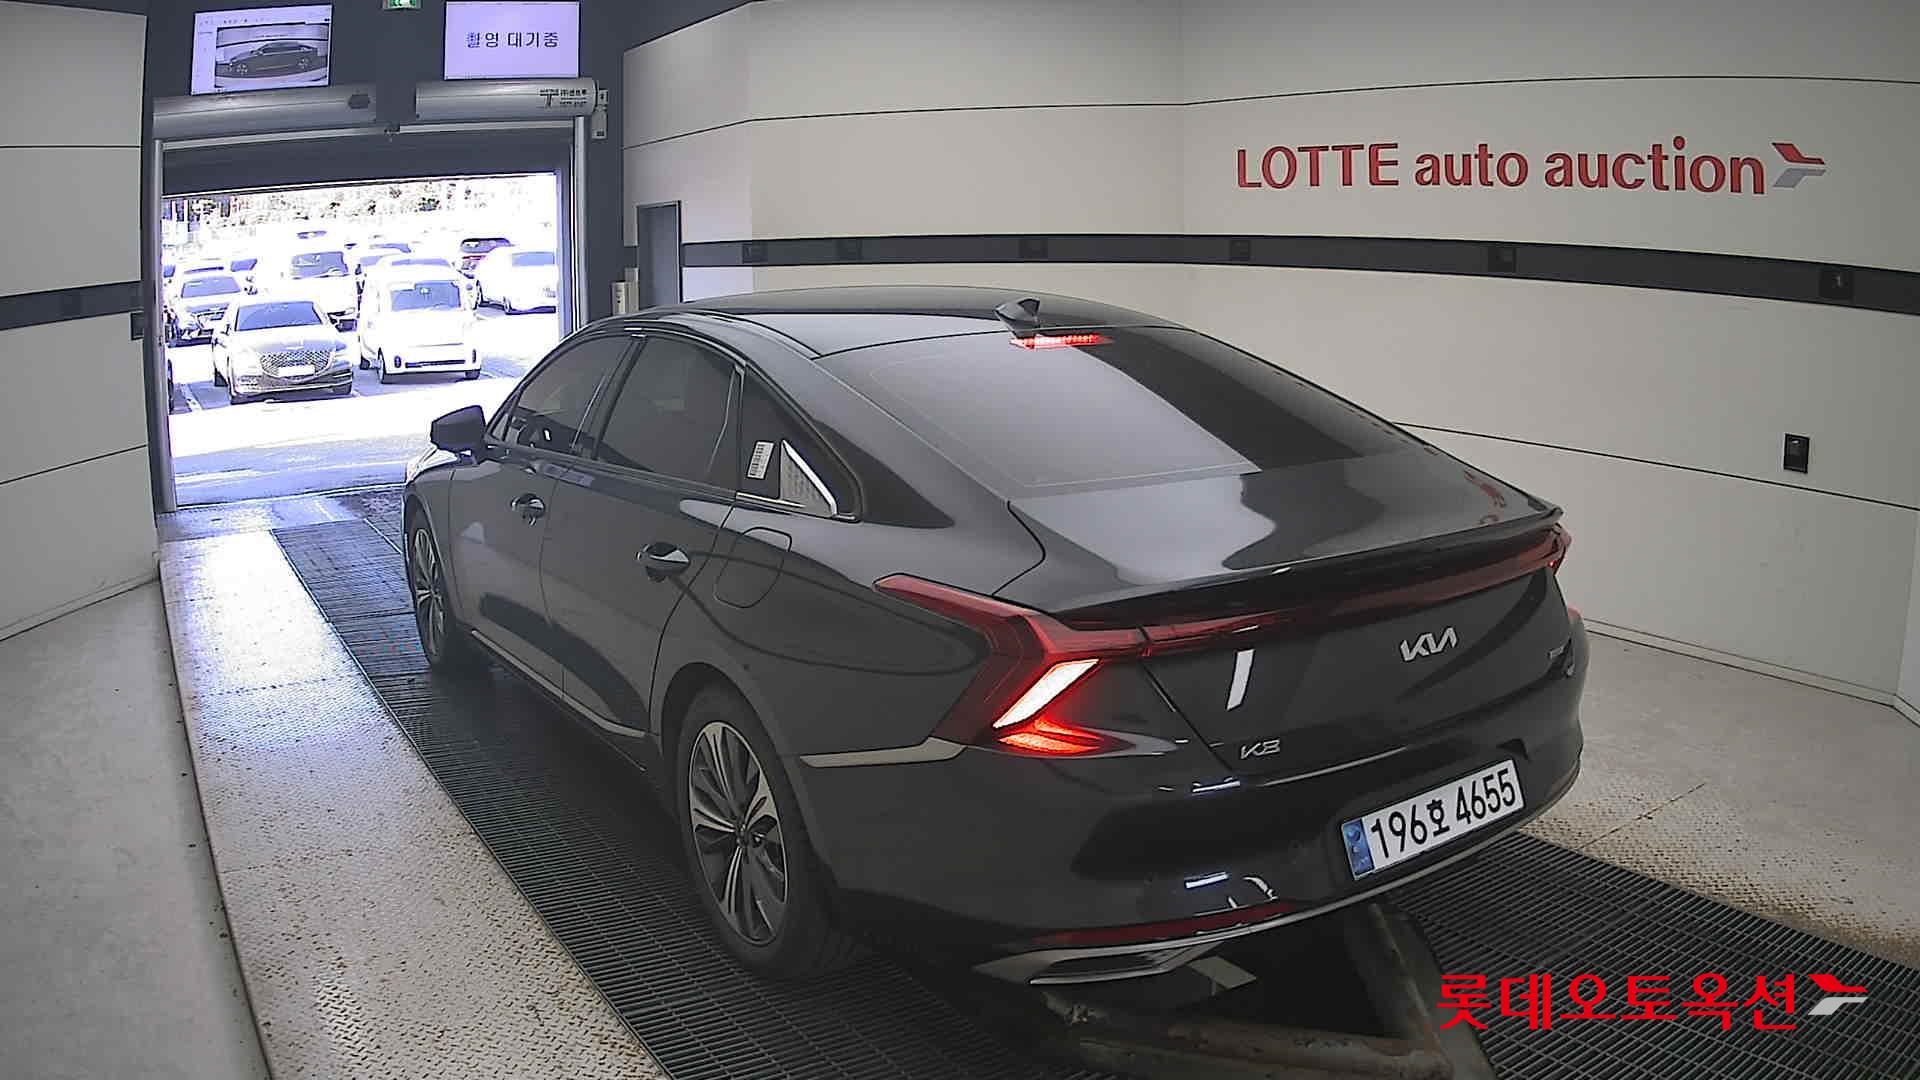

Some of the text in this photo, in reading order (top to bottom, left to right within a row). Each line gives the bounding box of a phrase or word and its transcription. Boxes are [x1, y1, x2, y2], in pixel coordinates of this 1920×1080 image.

[507, 31, 559, 48] 대기중
[1237, 135, 1765, 195] LOTTE auto auction
[1400, 626, 1458, 661] KIA
[1240, 738, 1281, 760] K8
[1371, 768, 1516, 859] 196호 4655
